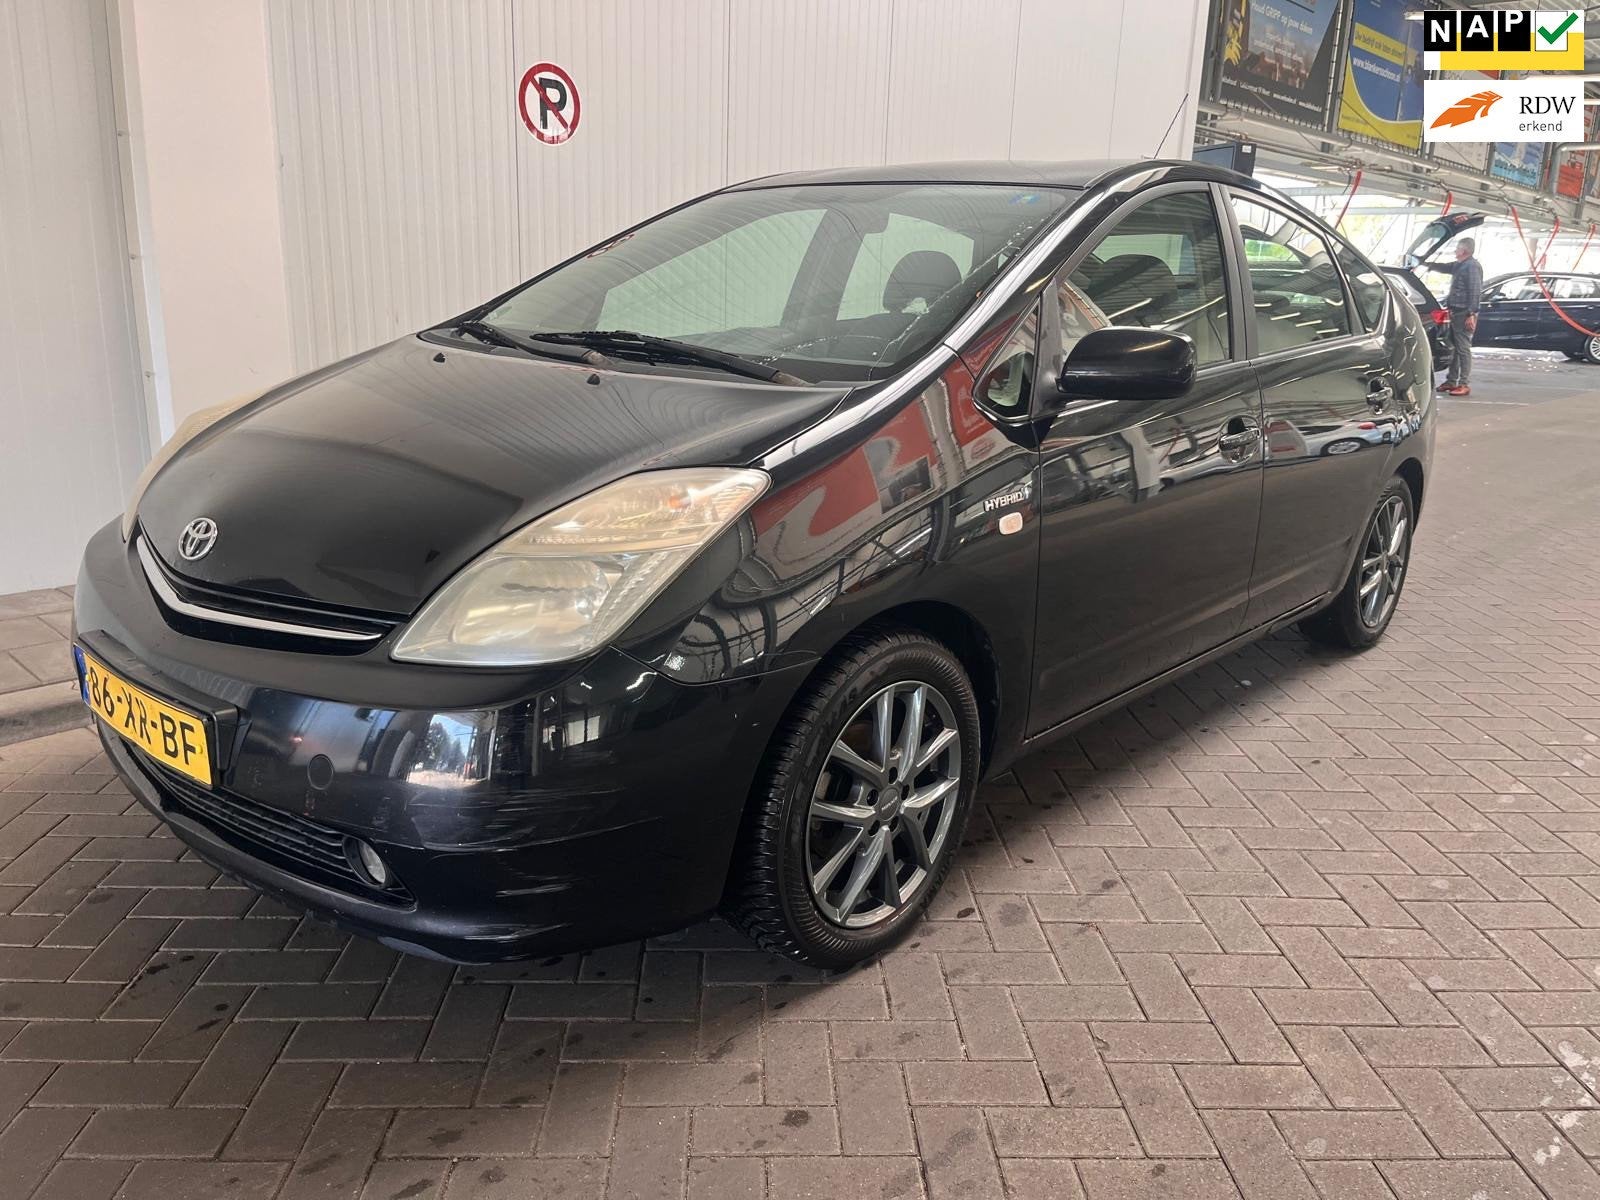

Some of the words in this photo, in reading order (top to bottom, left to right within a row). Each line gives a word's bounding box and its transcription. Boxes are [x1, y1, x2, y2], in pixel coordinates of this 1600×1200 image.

[539, 77, 567, 129] P
[983, 490, 1025, 511] HYBRID
[89, 666, 196, 765] 86-XR-BF
